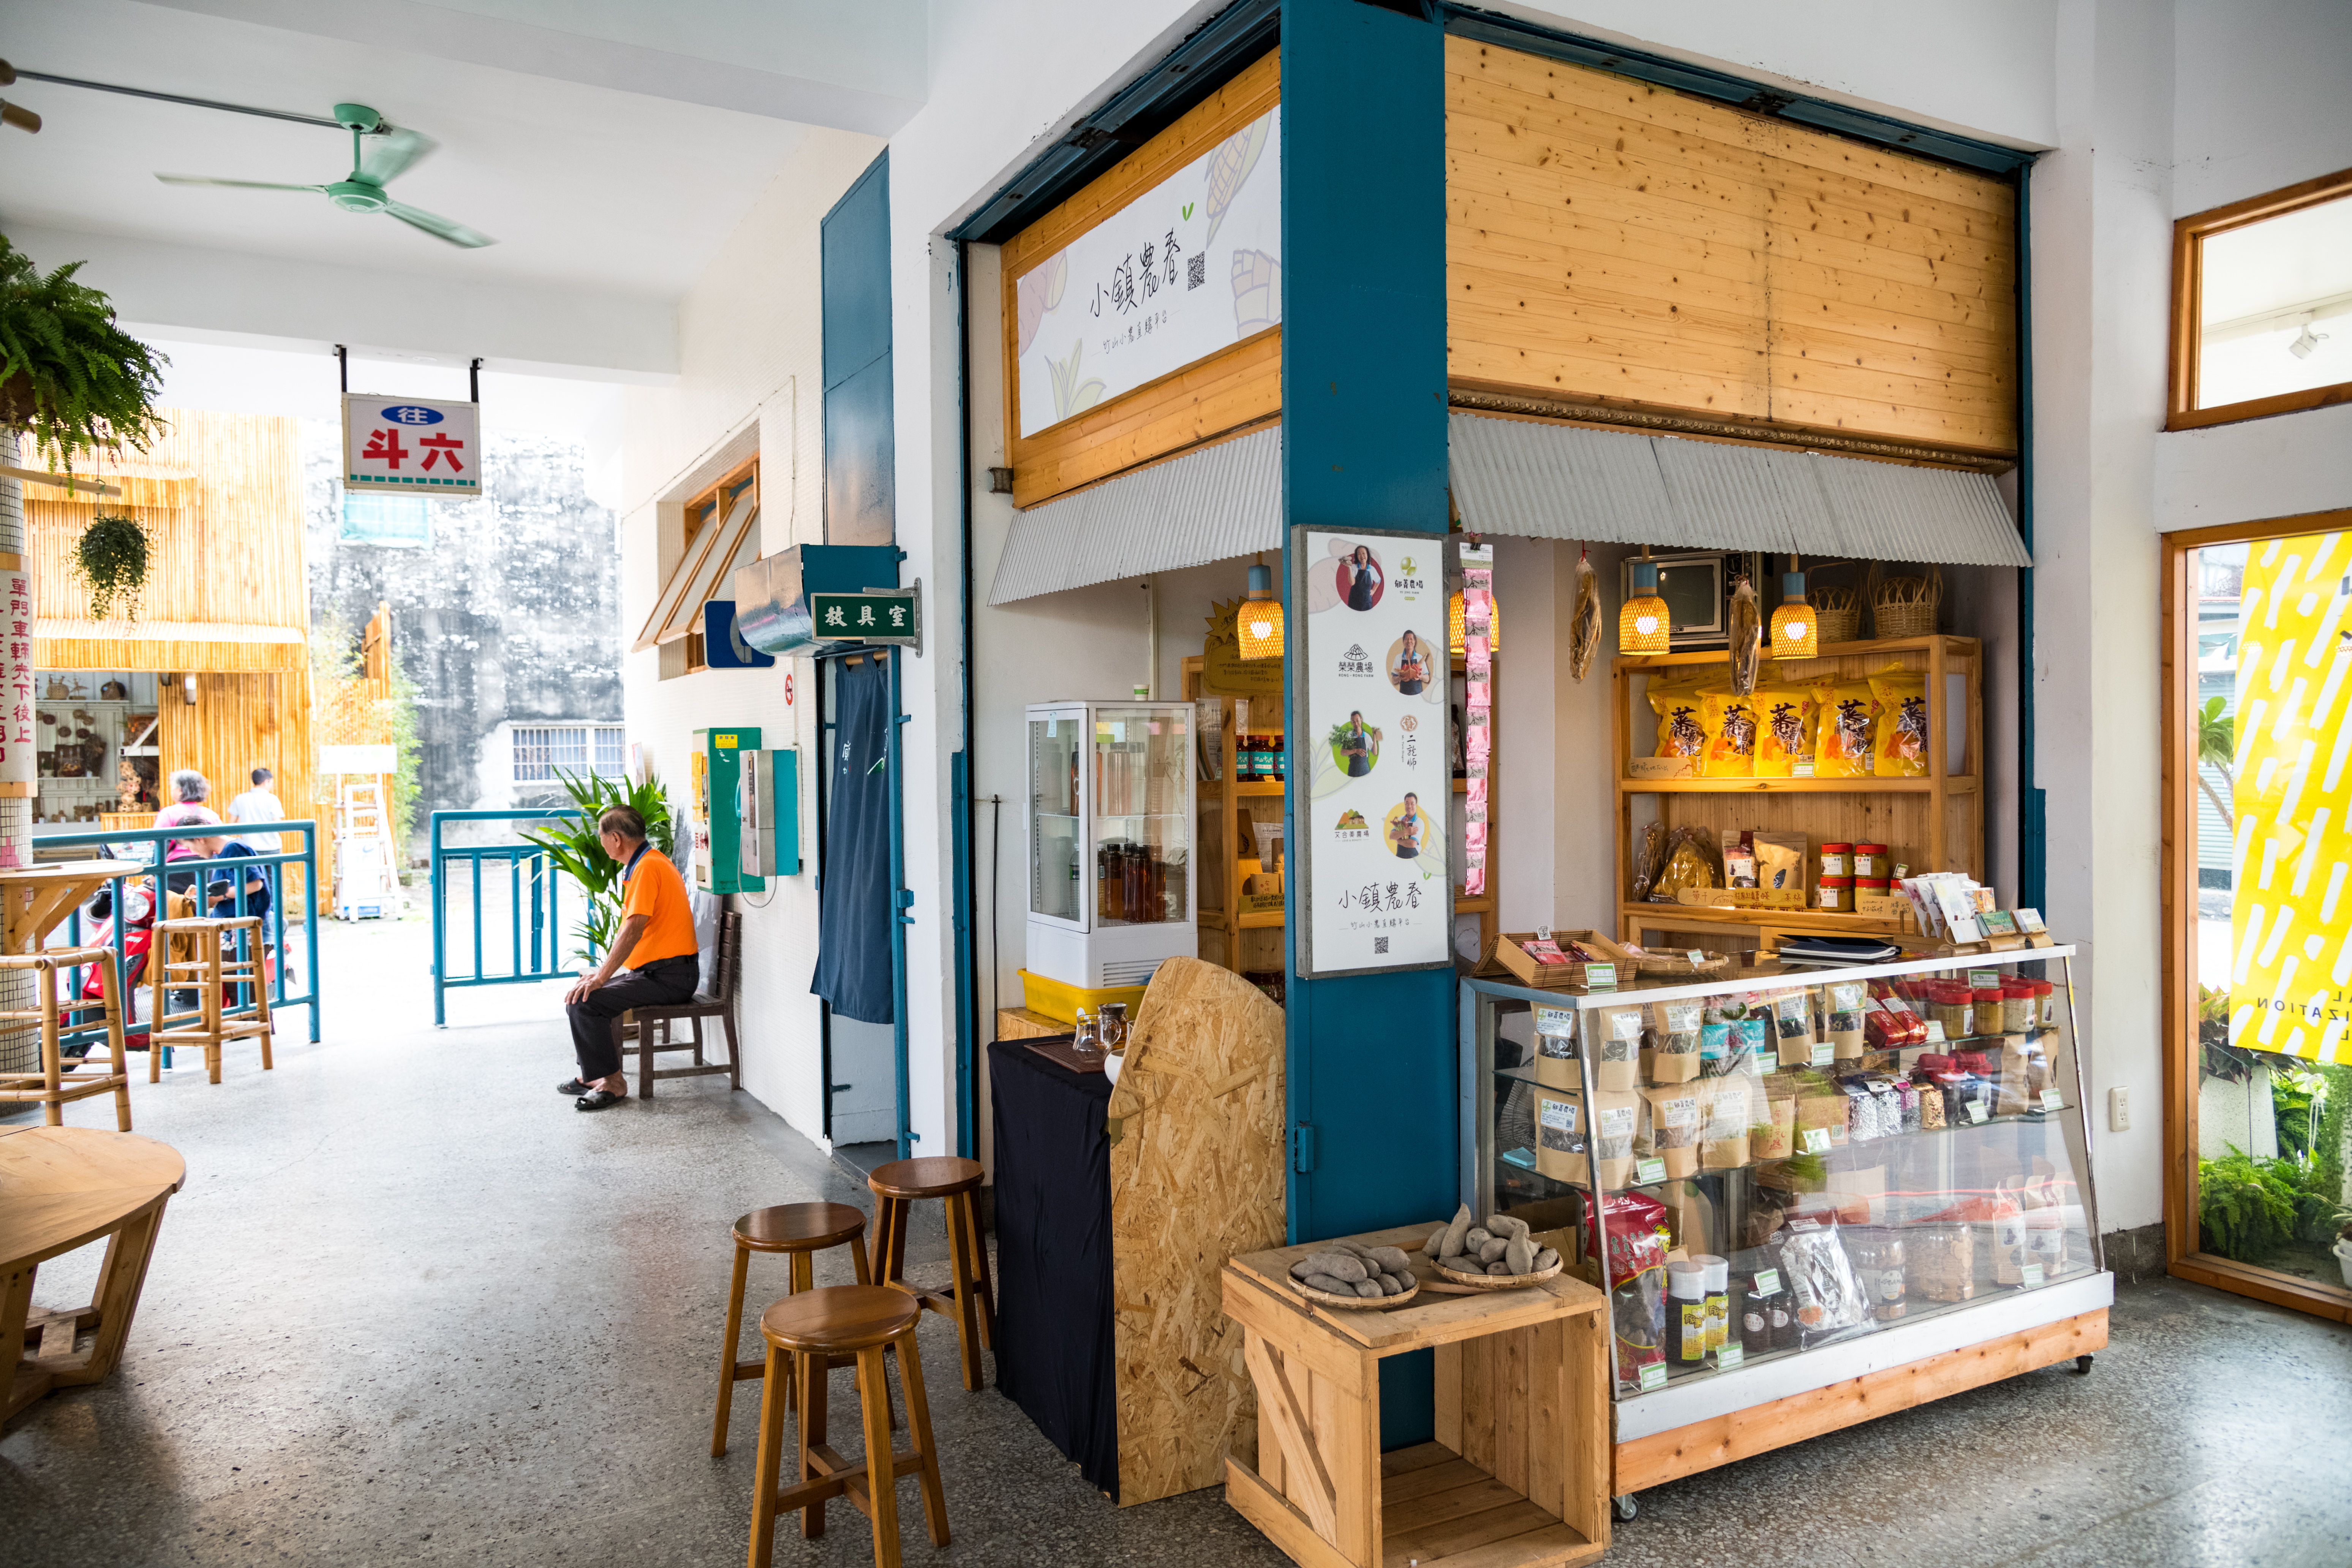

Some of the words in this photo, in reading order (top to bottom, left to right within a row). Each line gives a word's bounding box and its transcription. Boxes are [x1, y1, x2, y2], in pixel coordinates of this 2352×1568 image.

[398, 407, 428, 424] 往
[362, 428, 464, 473] 斗六
[825, 605, 906, 627] 教具室
[1339, 661, 1373, 673] 榮榮農場
